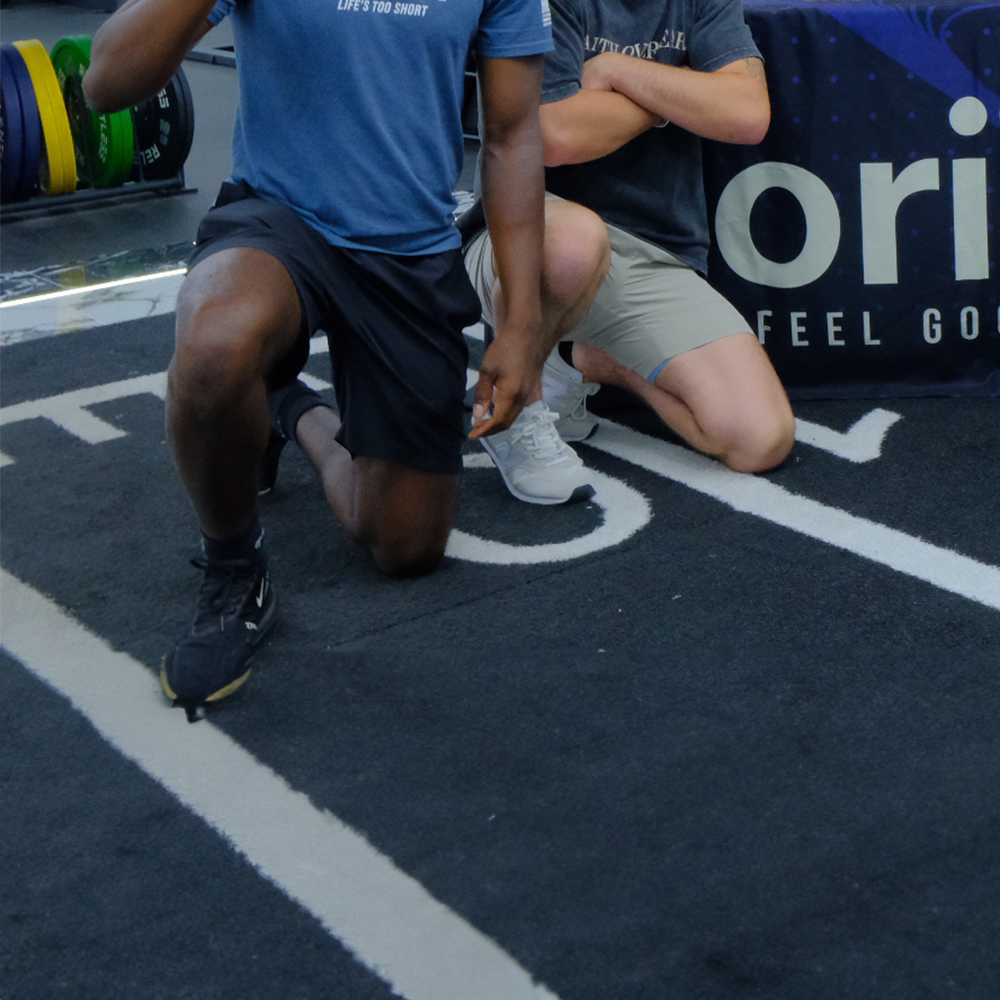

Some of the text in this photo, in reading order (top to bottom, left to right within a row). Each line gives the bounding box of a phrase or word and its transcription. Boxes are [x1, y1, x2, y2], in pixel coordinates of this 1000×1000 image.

[372, 0, 391, 14] TOO
[393, 2, 428, 17] SHORT
[756, 310, 881, 347] FEEL
